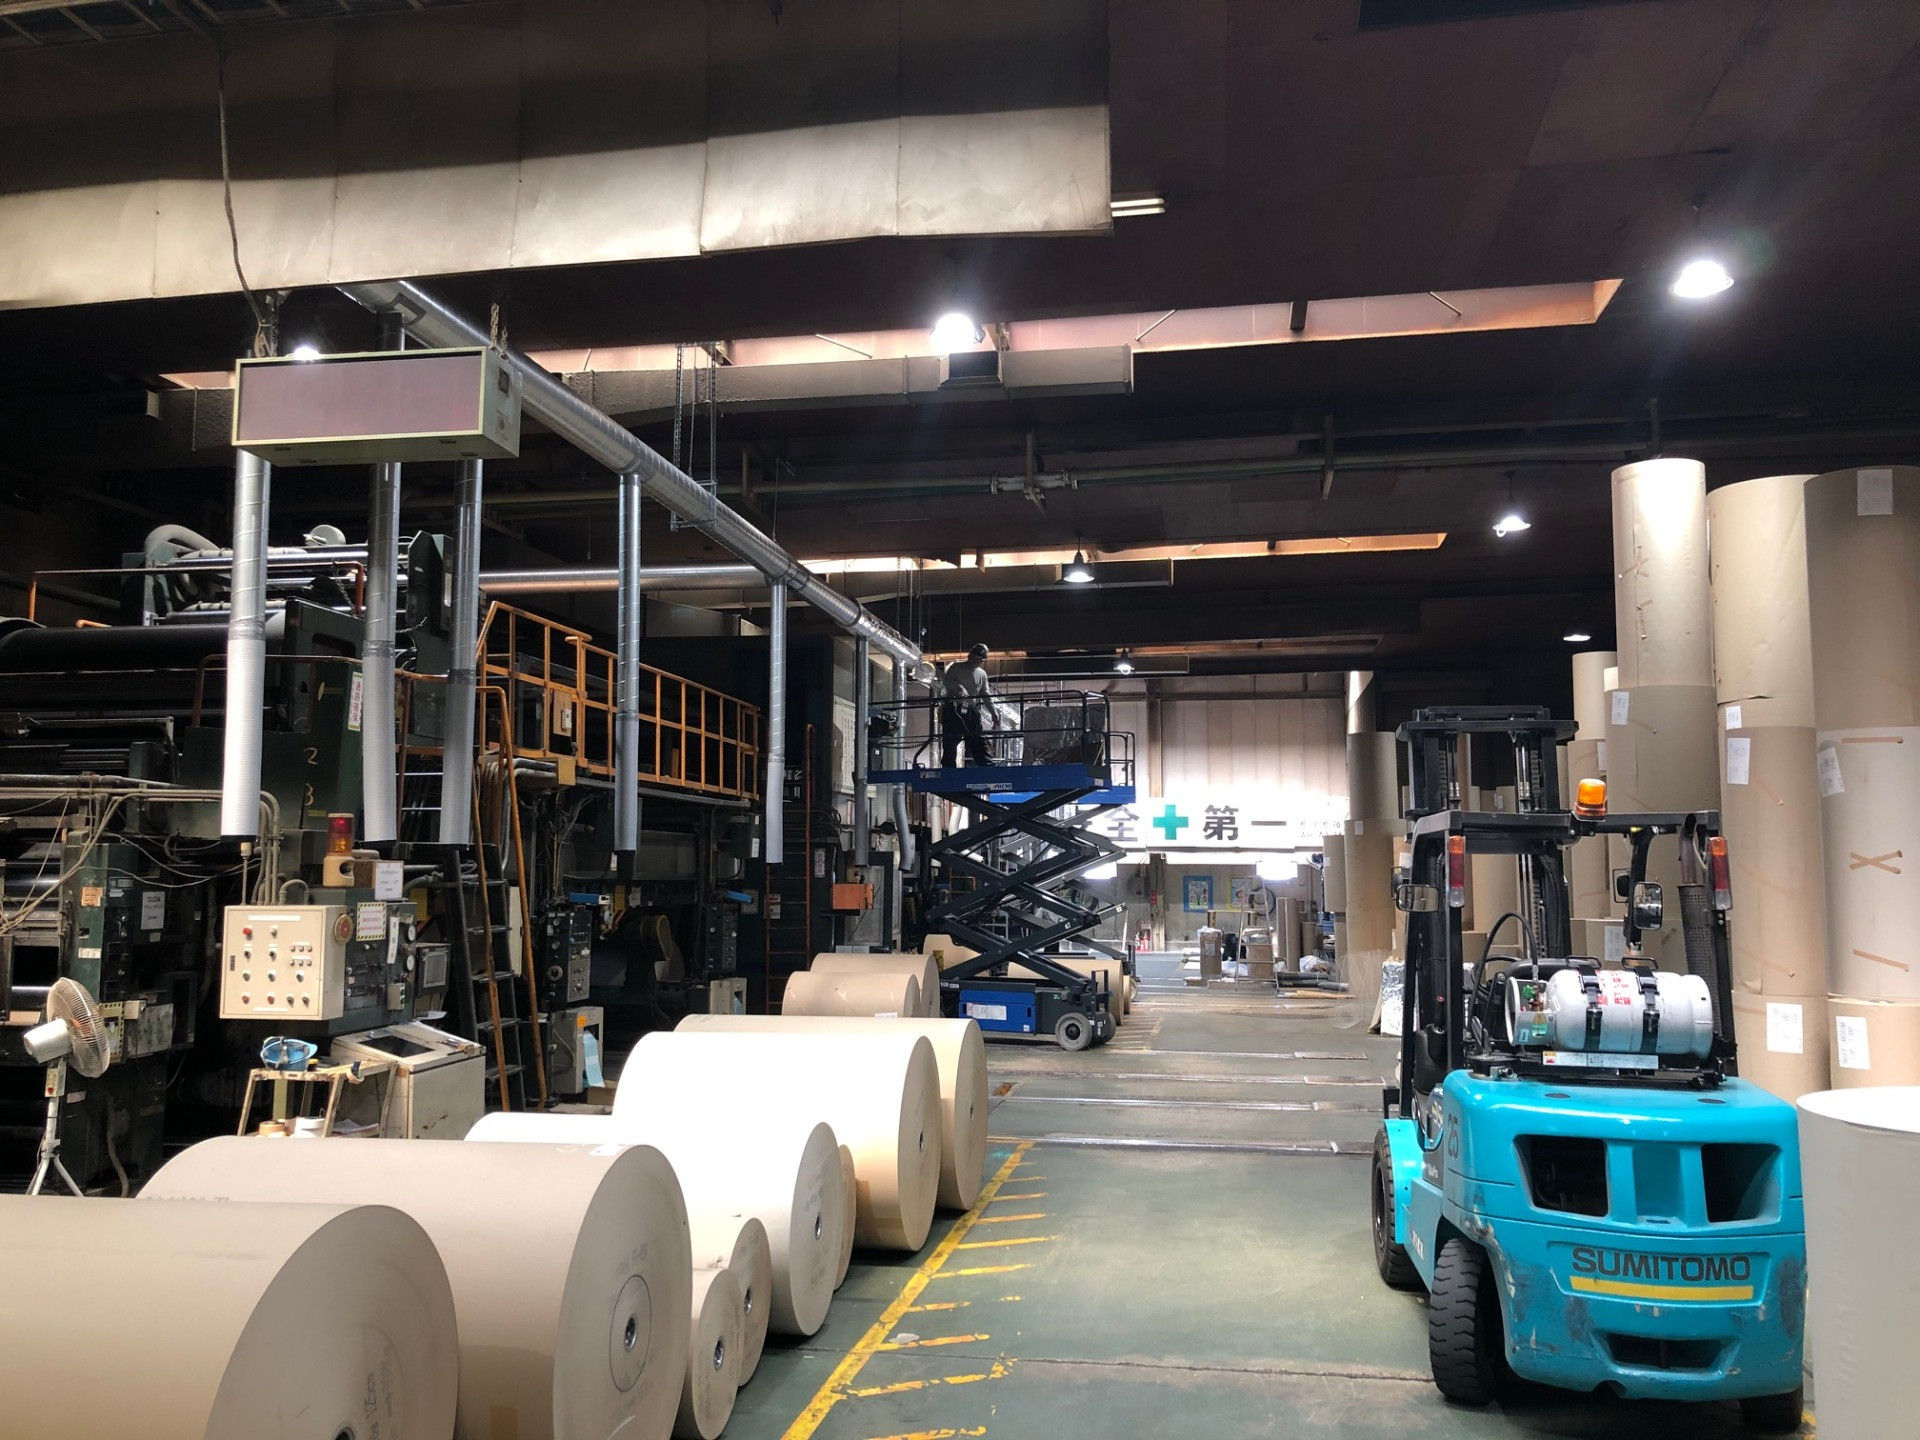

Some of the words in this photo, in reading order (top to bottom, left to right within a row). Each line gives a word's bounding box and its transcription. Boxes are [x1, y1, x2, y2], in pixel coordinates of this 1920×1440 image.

[303, 746, 319, 765] 2
[1202, 804, 1288, 841] 第一
[1571, 1246, 1750, 1282] SUMITOMO
